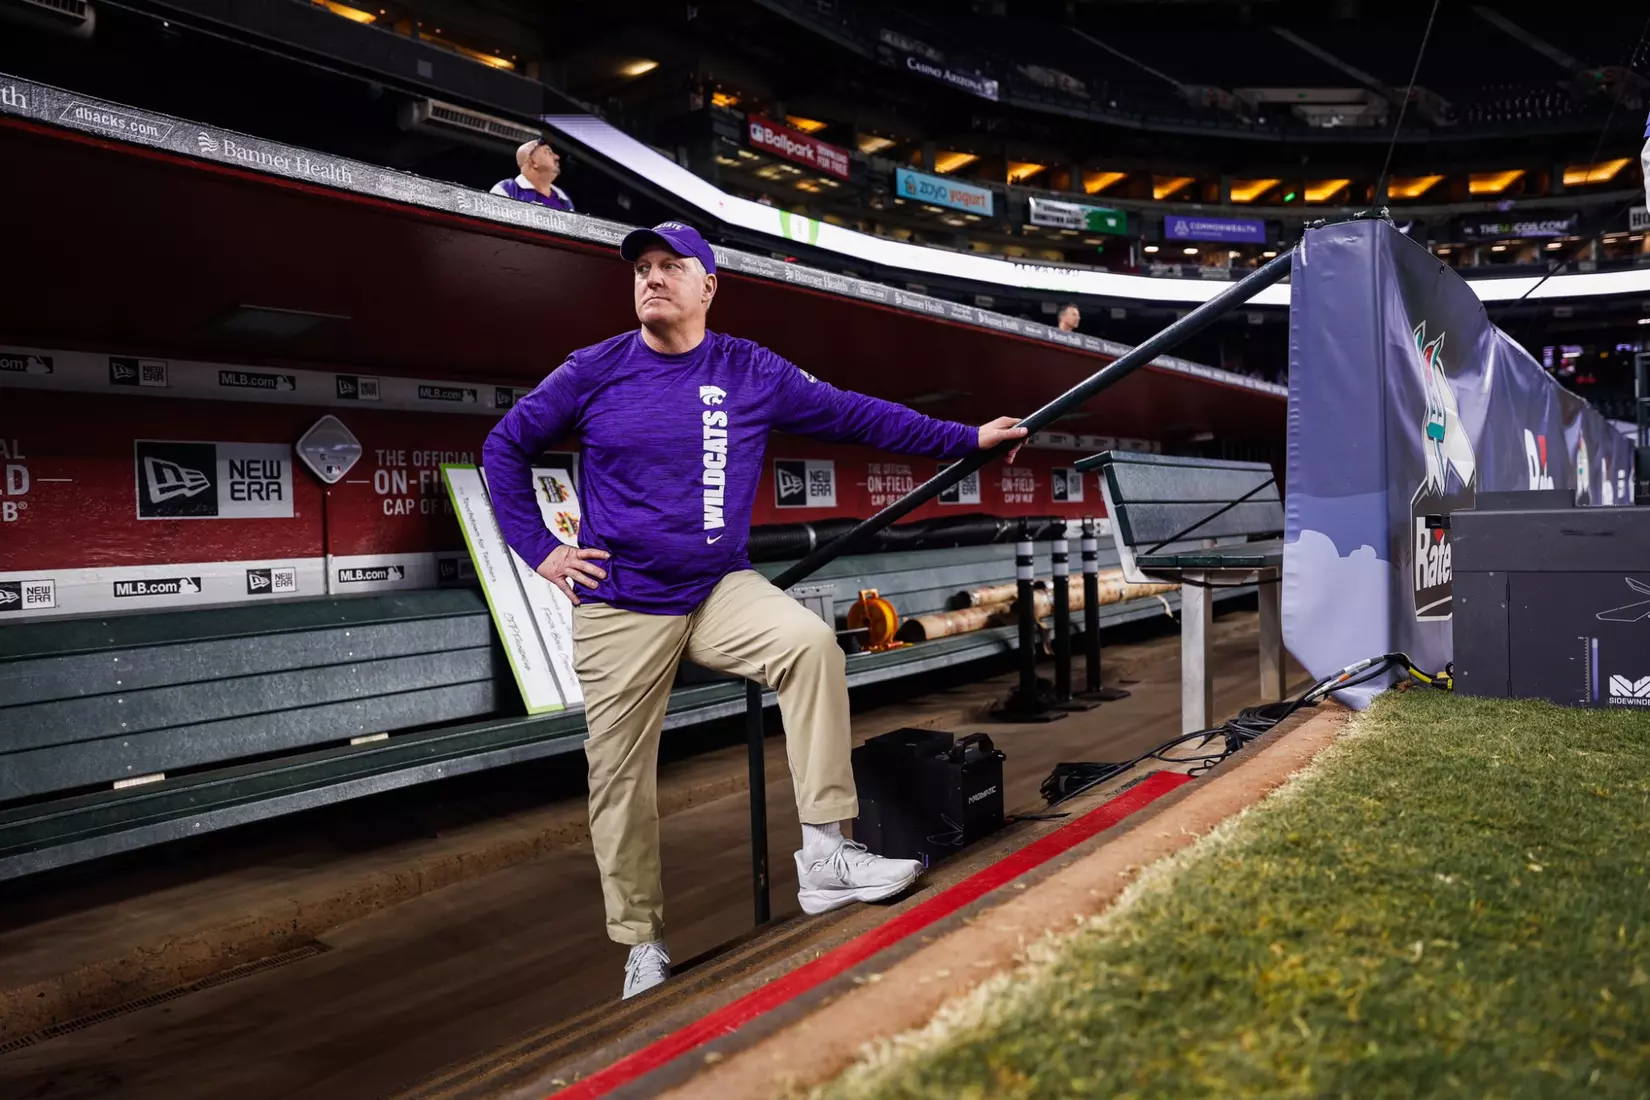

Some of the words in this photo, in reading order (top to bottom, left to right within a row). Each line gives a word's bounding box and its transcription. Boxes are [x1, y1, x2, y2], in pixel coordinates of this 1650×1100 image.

[75, 107, 159, 136] dbacks.com
[764, 127, 815, 160] Ballpark
[223, 139, 291, 171] Banner
[296, 156, 353, 183] Health
[816, 155, 830, 169] FOR
[831, 161, 849, 177] FREE
[948, 188, 986, 209] yogurt
[474, 199, 522, 221] Banner
[525, 208, 567, 230] Health
[1189, 222, 1257, 233] COMMONWEALTH
[794, 269, 823, 286] Banner
[823, 276, 848, 292] Health
[142, 365, 164, 374] NEW
[143, 373, 165, 382] ERA
[221, 372, 275, 387] MLB.com
[420, 386, 461, 400] MLB.com
[375, 449, 407, 467] THE
[412, 450, 476, 467] OFFICIAL
[228, 458, 282, 480] NEW
[702, 410, 728, 531] WILDCATS
[808, 470, 831, 483] NEW
[229, 480, 283, 501] ERA
[810, 483, 832, 497] ERA
[867, 475, 914, 493] ON-FIELD
[1001, 478, 1035, 492] ON-FIELD
[383, 498, 415, 516] CAP
[420, 498, 439, 515] OF
[871, 494, 886, 507] CAP
[274, 572, 293, 581] NEW
[340, 570, 387, 582] MLB.com
[26, 585, 51, 595] NEW
[116, 582, 178, 596] MLB.com
[275, 580, 293, 588] ERA
[27, 594, 51, 603] ERA
